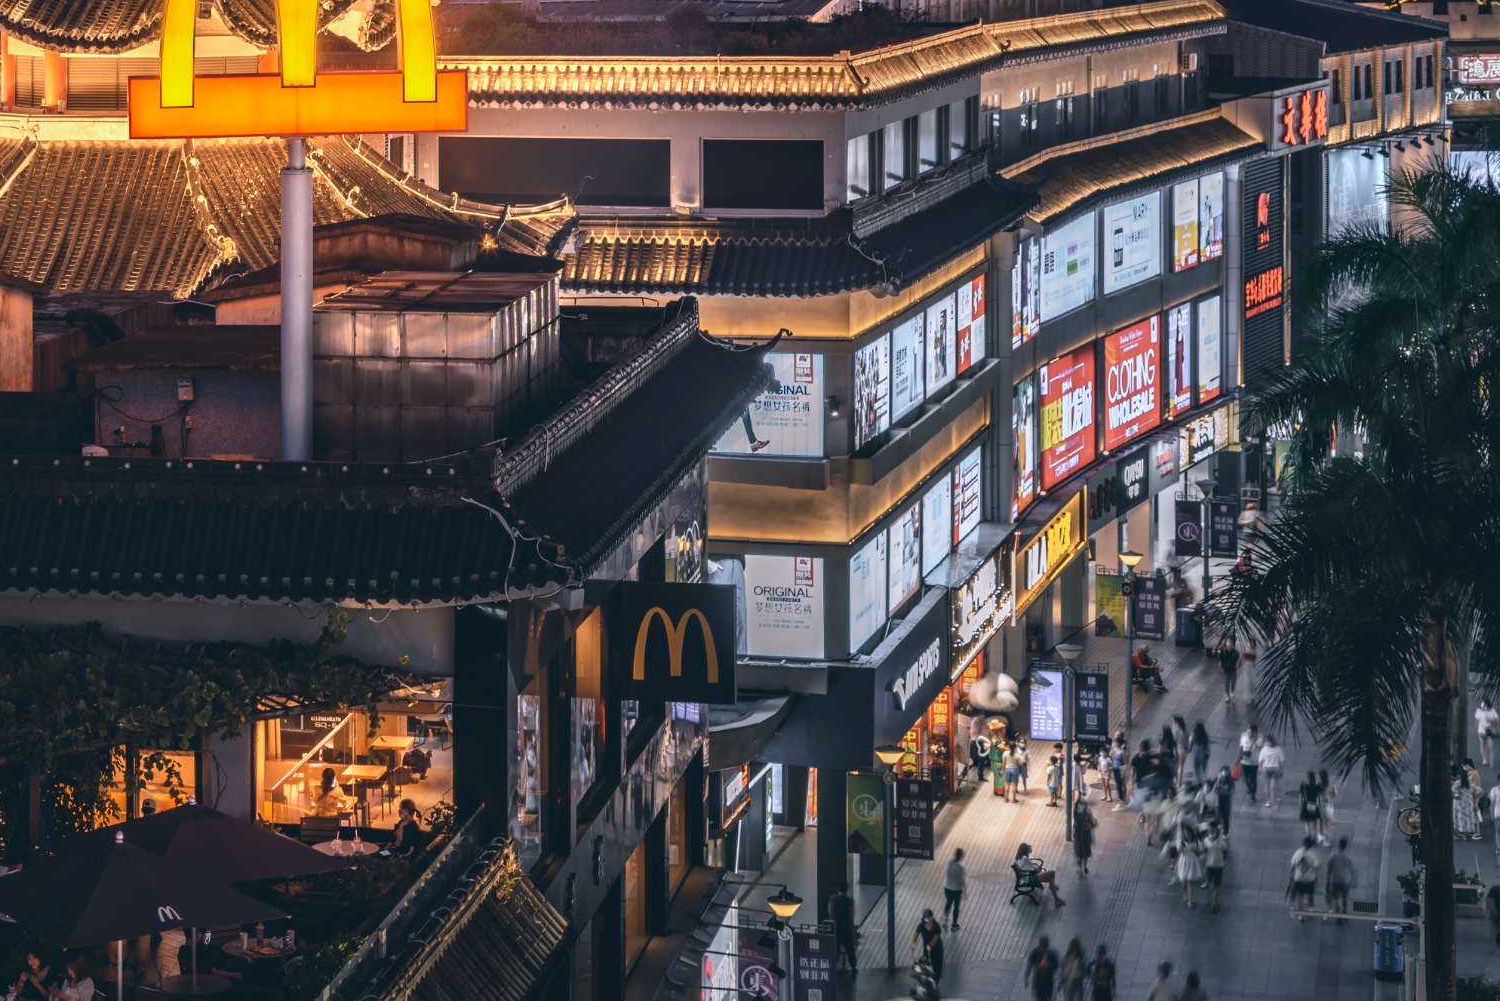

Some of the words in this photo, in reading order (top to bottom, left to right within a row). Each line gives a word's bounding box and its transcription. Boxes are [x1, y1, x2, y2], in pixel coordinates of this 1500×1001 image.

[766, 384, 812, 396] INAL
[1108, 386, 1155, 431] WHOLESALE
[753, 585, 813, 598] ORIGINAL
[800, 957, 830, 969] 选正品
[800, 969, 829, 982] 到非凡
